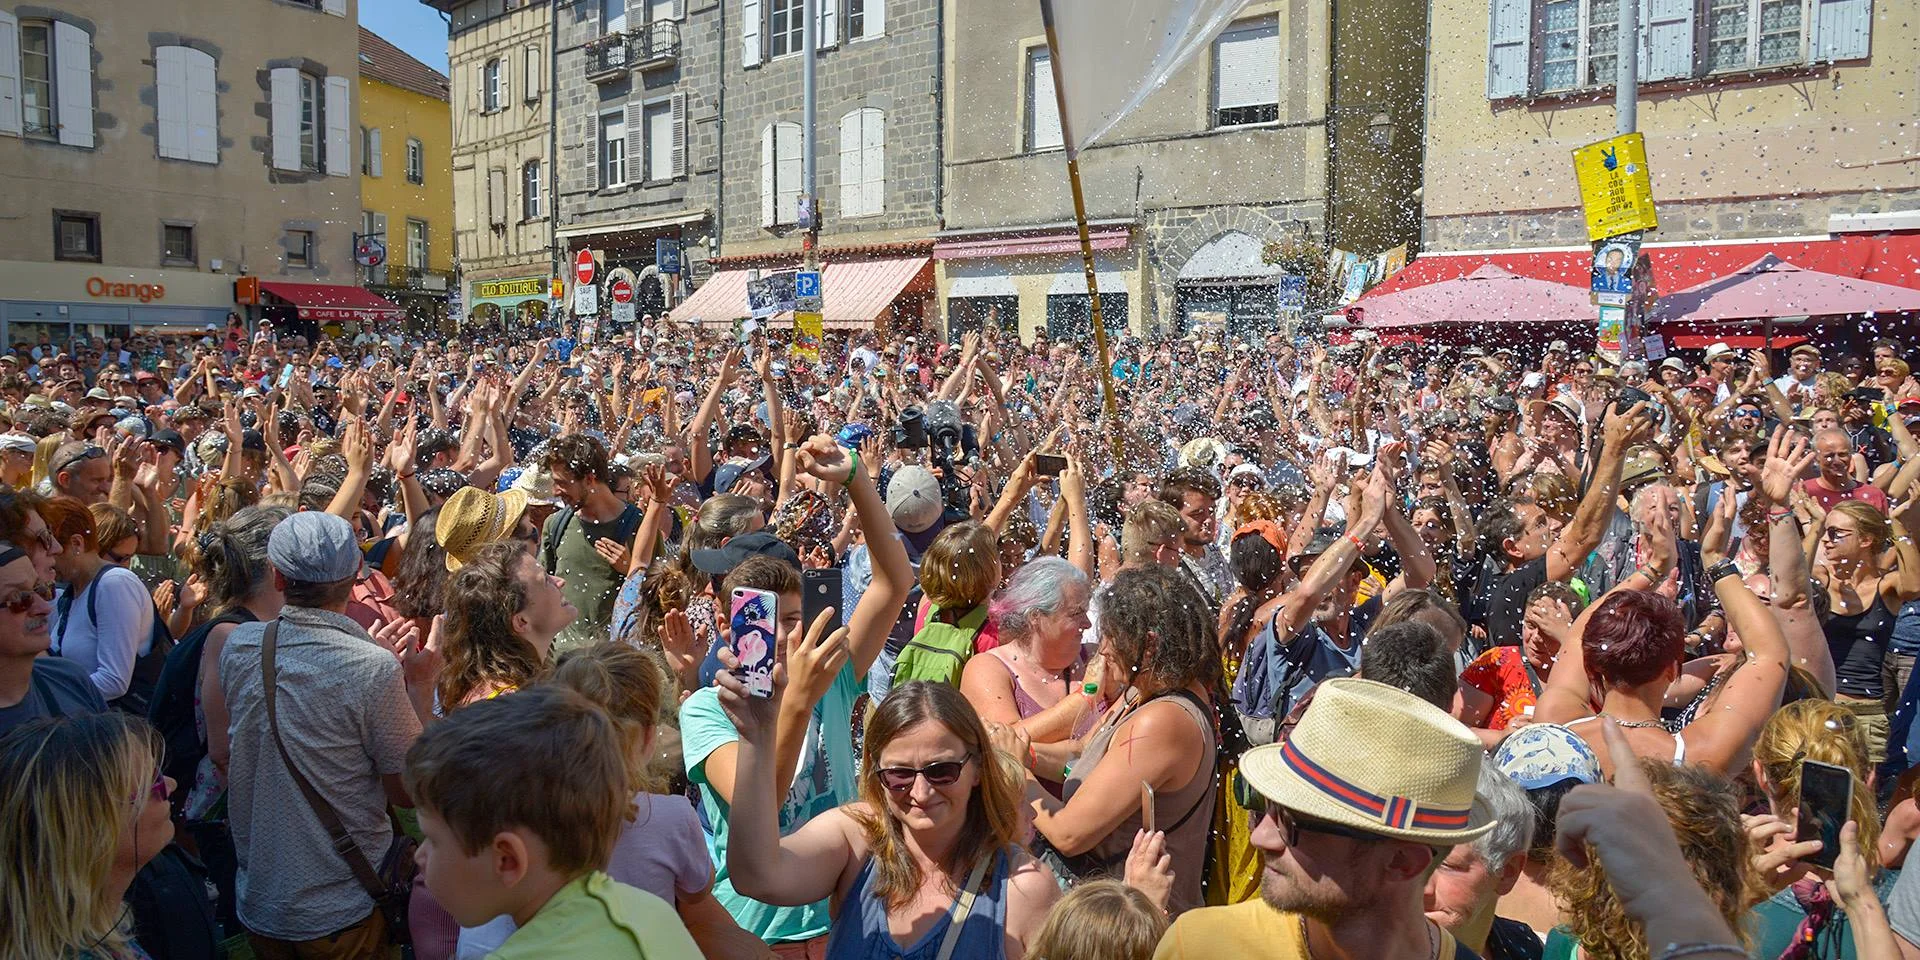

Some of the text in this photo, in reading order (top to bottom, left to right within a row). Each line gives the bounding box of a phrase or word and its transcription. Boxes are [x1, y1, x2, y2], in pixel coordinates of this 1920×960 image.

[1610, 171, 1619, 180] LA
[1608, 179, 1624, 189] COU
[86, 277, 165, 303] Orange
[481, 281, 539, 296] CLO BOUTIQUE
[802, 276, 813, 293] P
